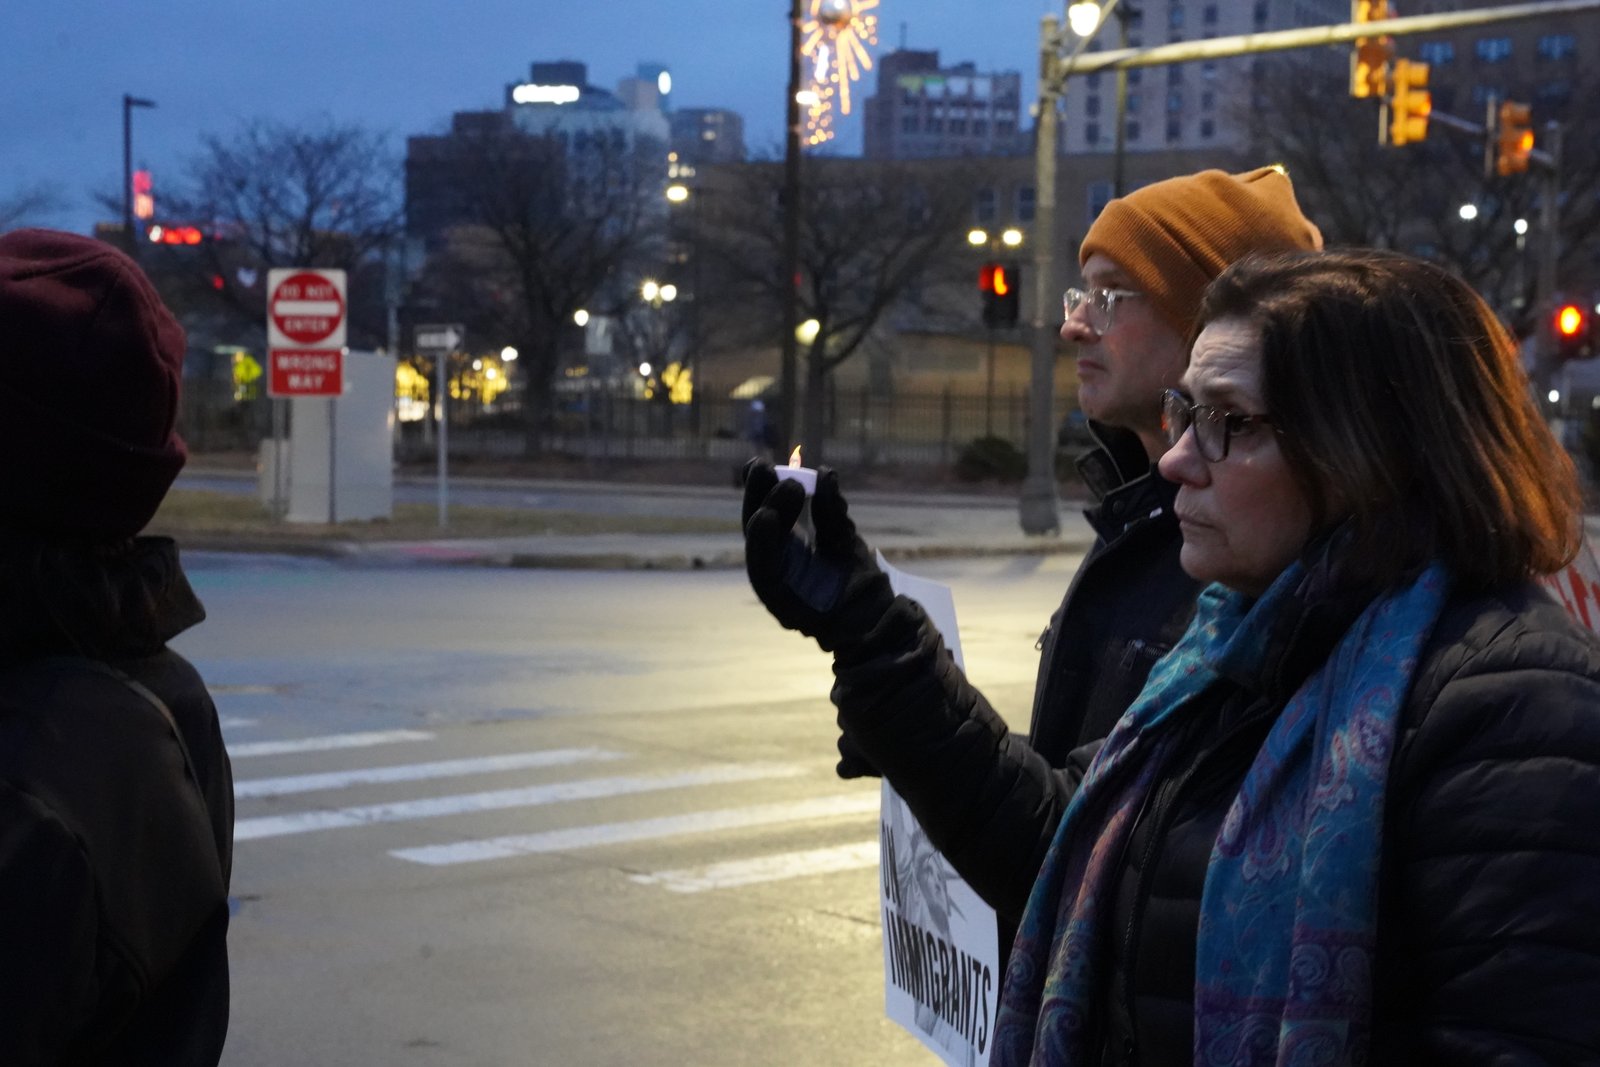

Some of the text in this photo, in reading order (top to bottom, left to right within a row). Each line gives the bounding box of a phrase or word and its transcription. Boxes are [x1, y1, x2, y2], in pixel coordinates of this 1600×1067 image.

[281, 284, 334, 298] DO NOT
[284, 318, 329, 332] ENTER
[278, 355, 336, 371] WRONG
[287, 374, 325, 389] WAY
[886, 906, 992, 1055] IMMIGRANTS
